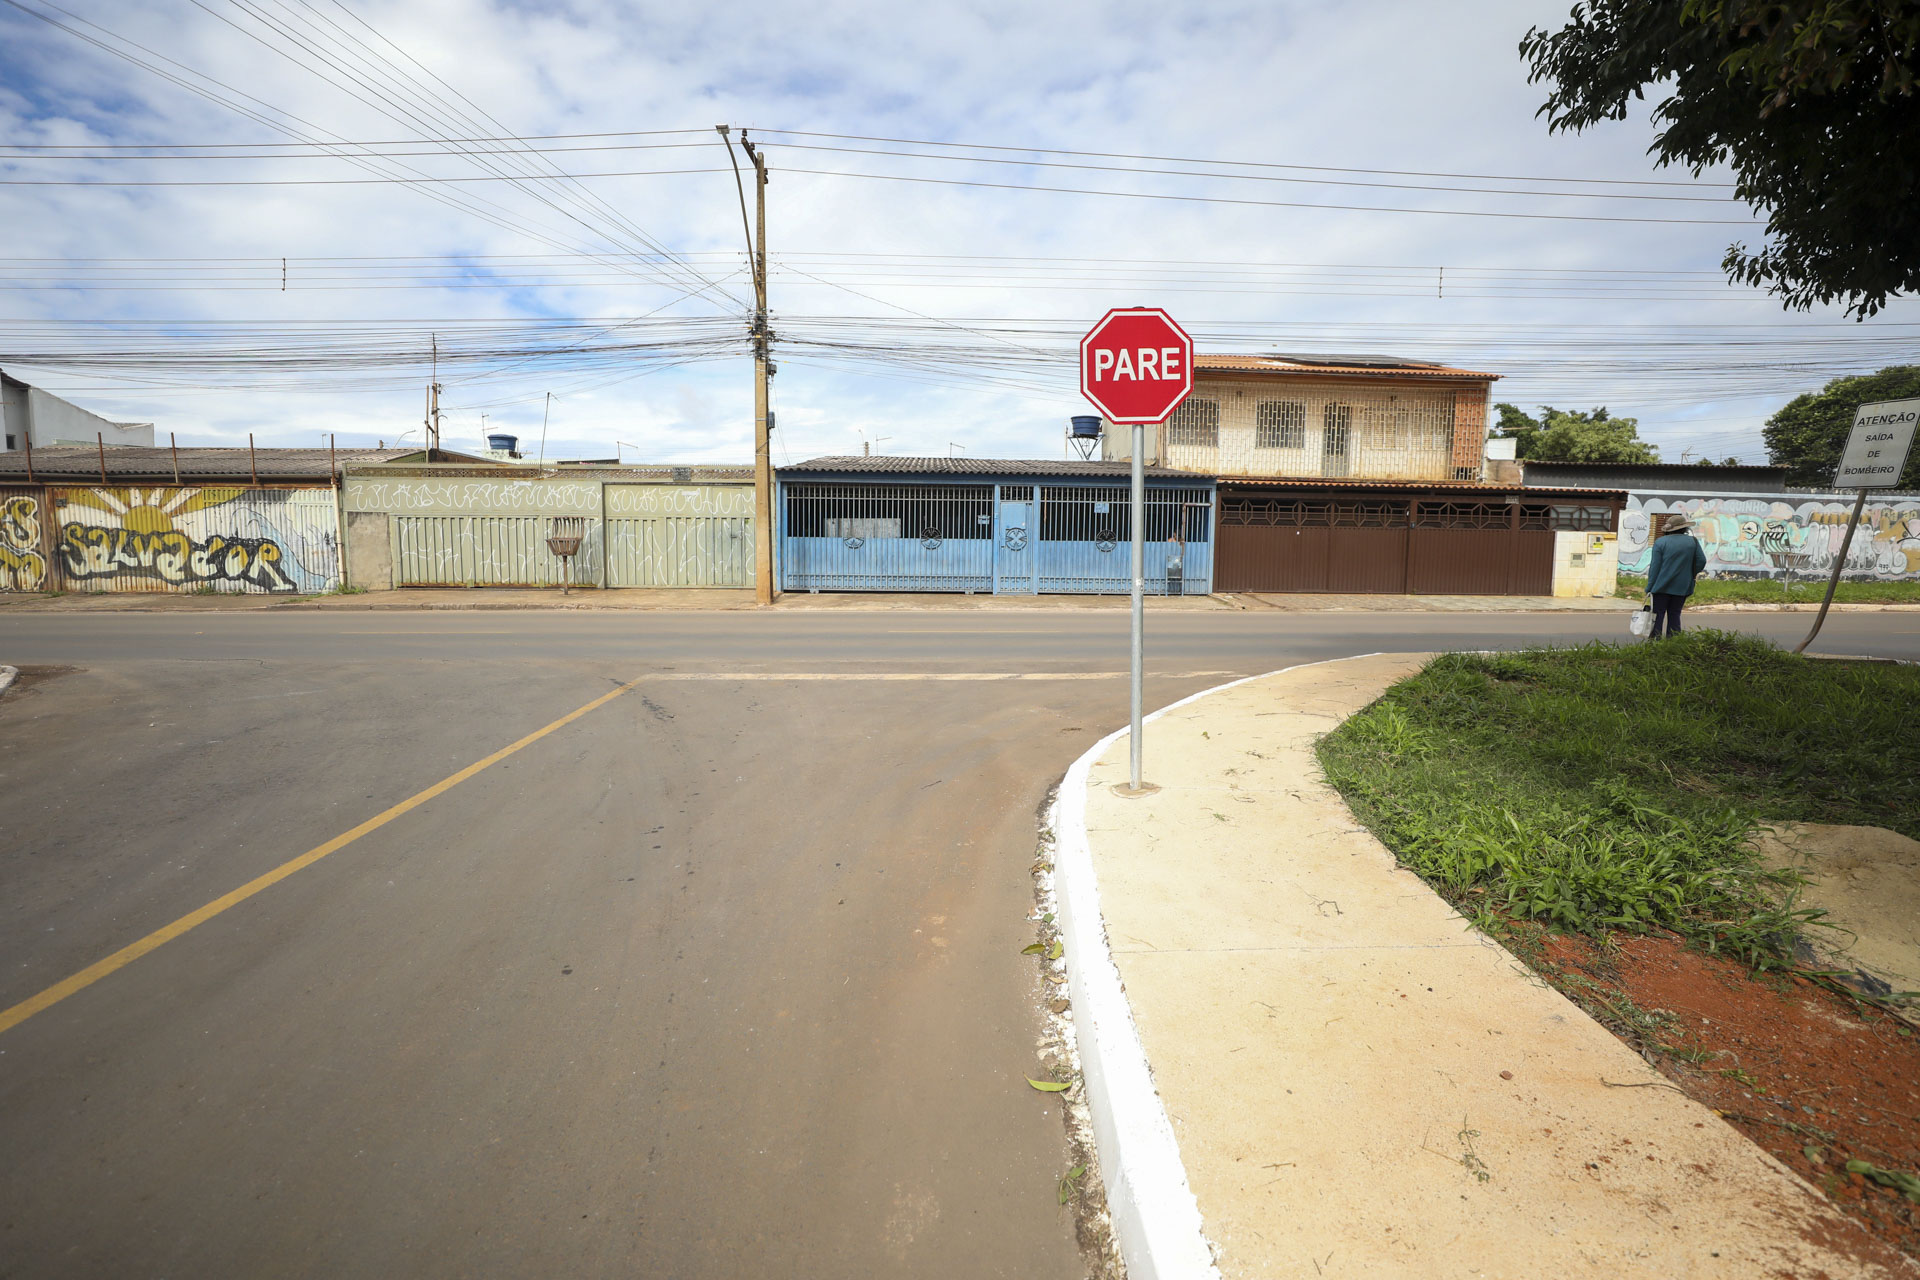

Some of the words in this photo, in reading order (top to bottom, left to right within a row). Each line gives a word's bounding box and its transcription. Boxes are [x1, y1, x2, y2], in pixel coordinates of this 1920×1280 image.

[1095, 347, 1181, 382] PARE
[1857, 412, 1916, 426] ATENÇÃO
[1865, 433, 1894, 442] SAÍDA
[1867, 450, 1881, 458] DE
[1844, 466, 1895, 475] BOMBEIRO
